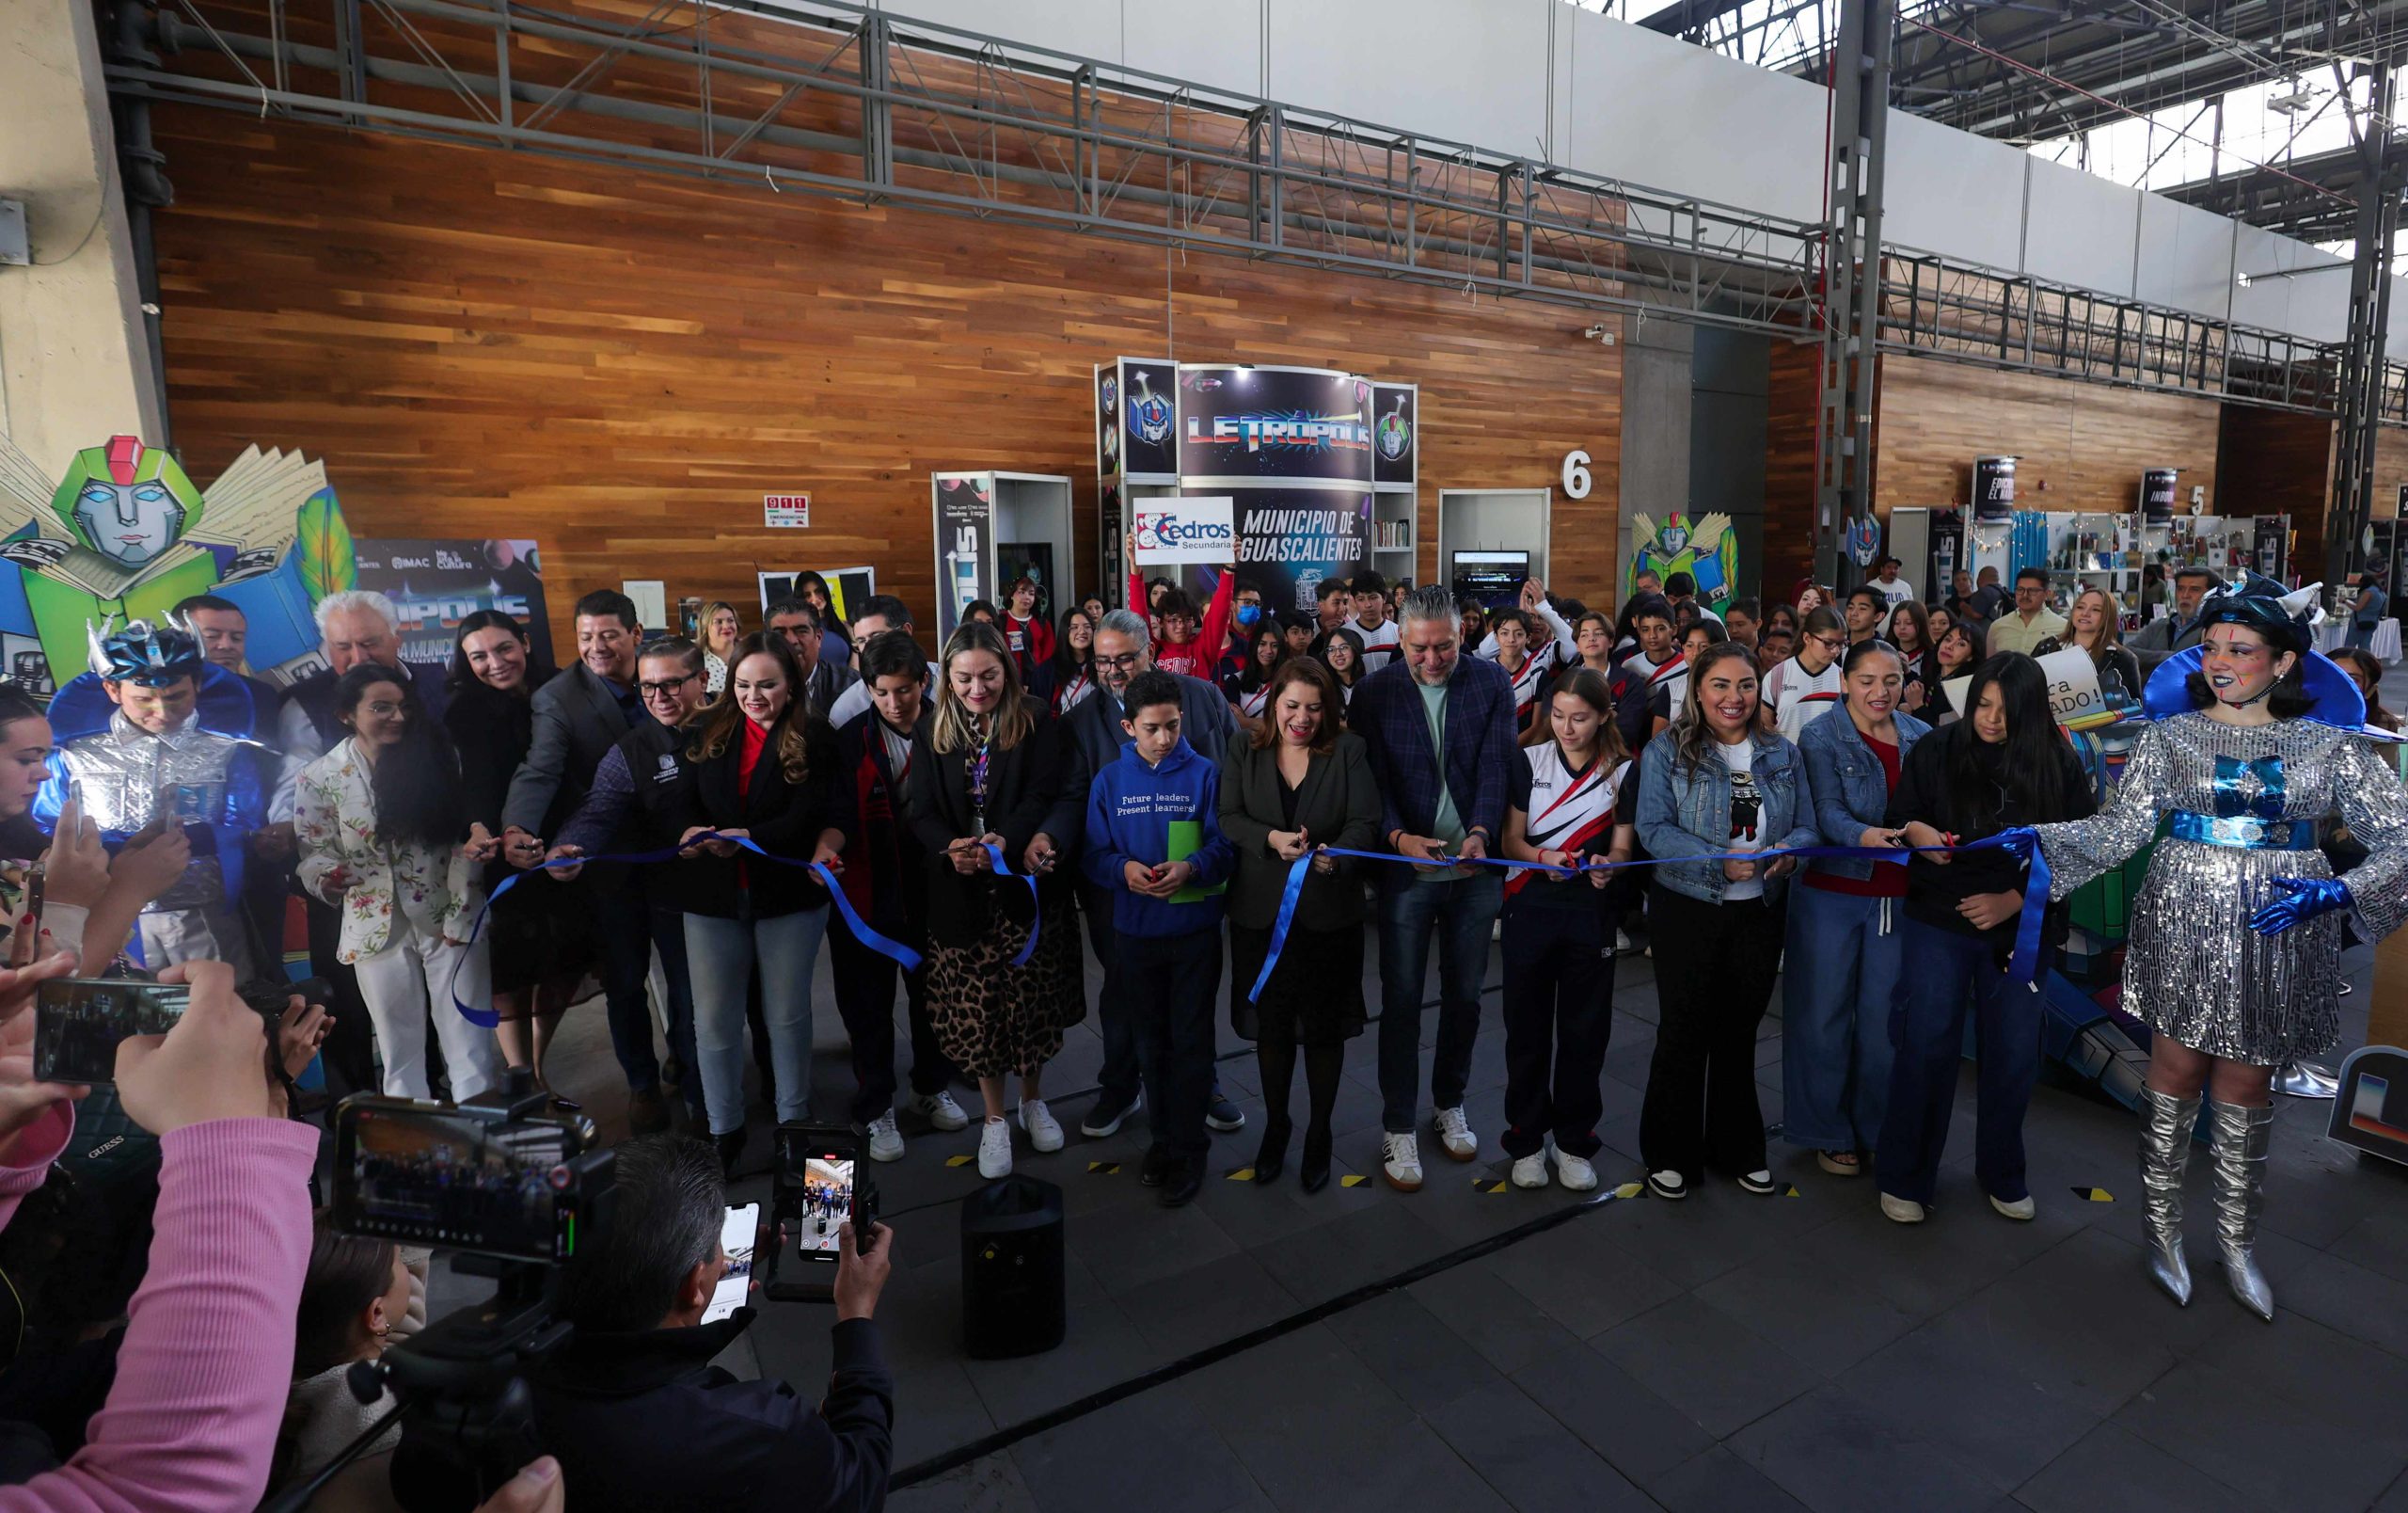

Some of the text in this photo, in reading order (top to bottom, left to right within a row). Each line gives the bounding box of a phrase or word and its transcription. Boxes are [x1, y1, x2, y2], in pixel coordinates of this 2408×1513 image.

[1563, 450, 1592, 499] 6
[768, 498, 803, 508] 911
[2191, 486, 2204, 516] 5
[1155, 516, 1231, 546] Cedros
[1243, 509, 1355, 534] MUNICIPIO DE
[1182, 541, 1231, 549] Secundaria
[1117, 804, 1196, 816] Present learners!
[1122, 793, 1190, 805] Future leaders
[88, 1135, 124, 1158] GUESS
